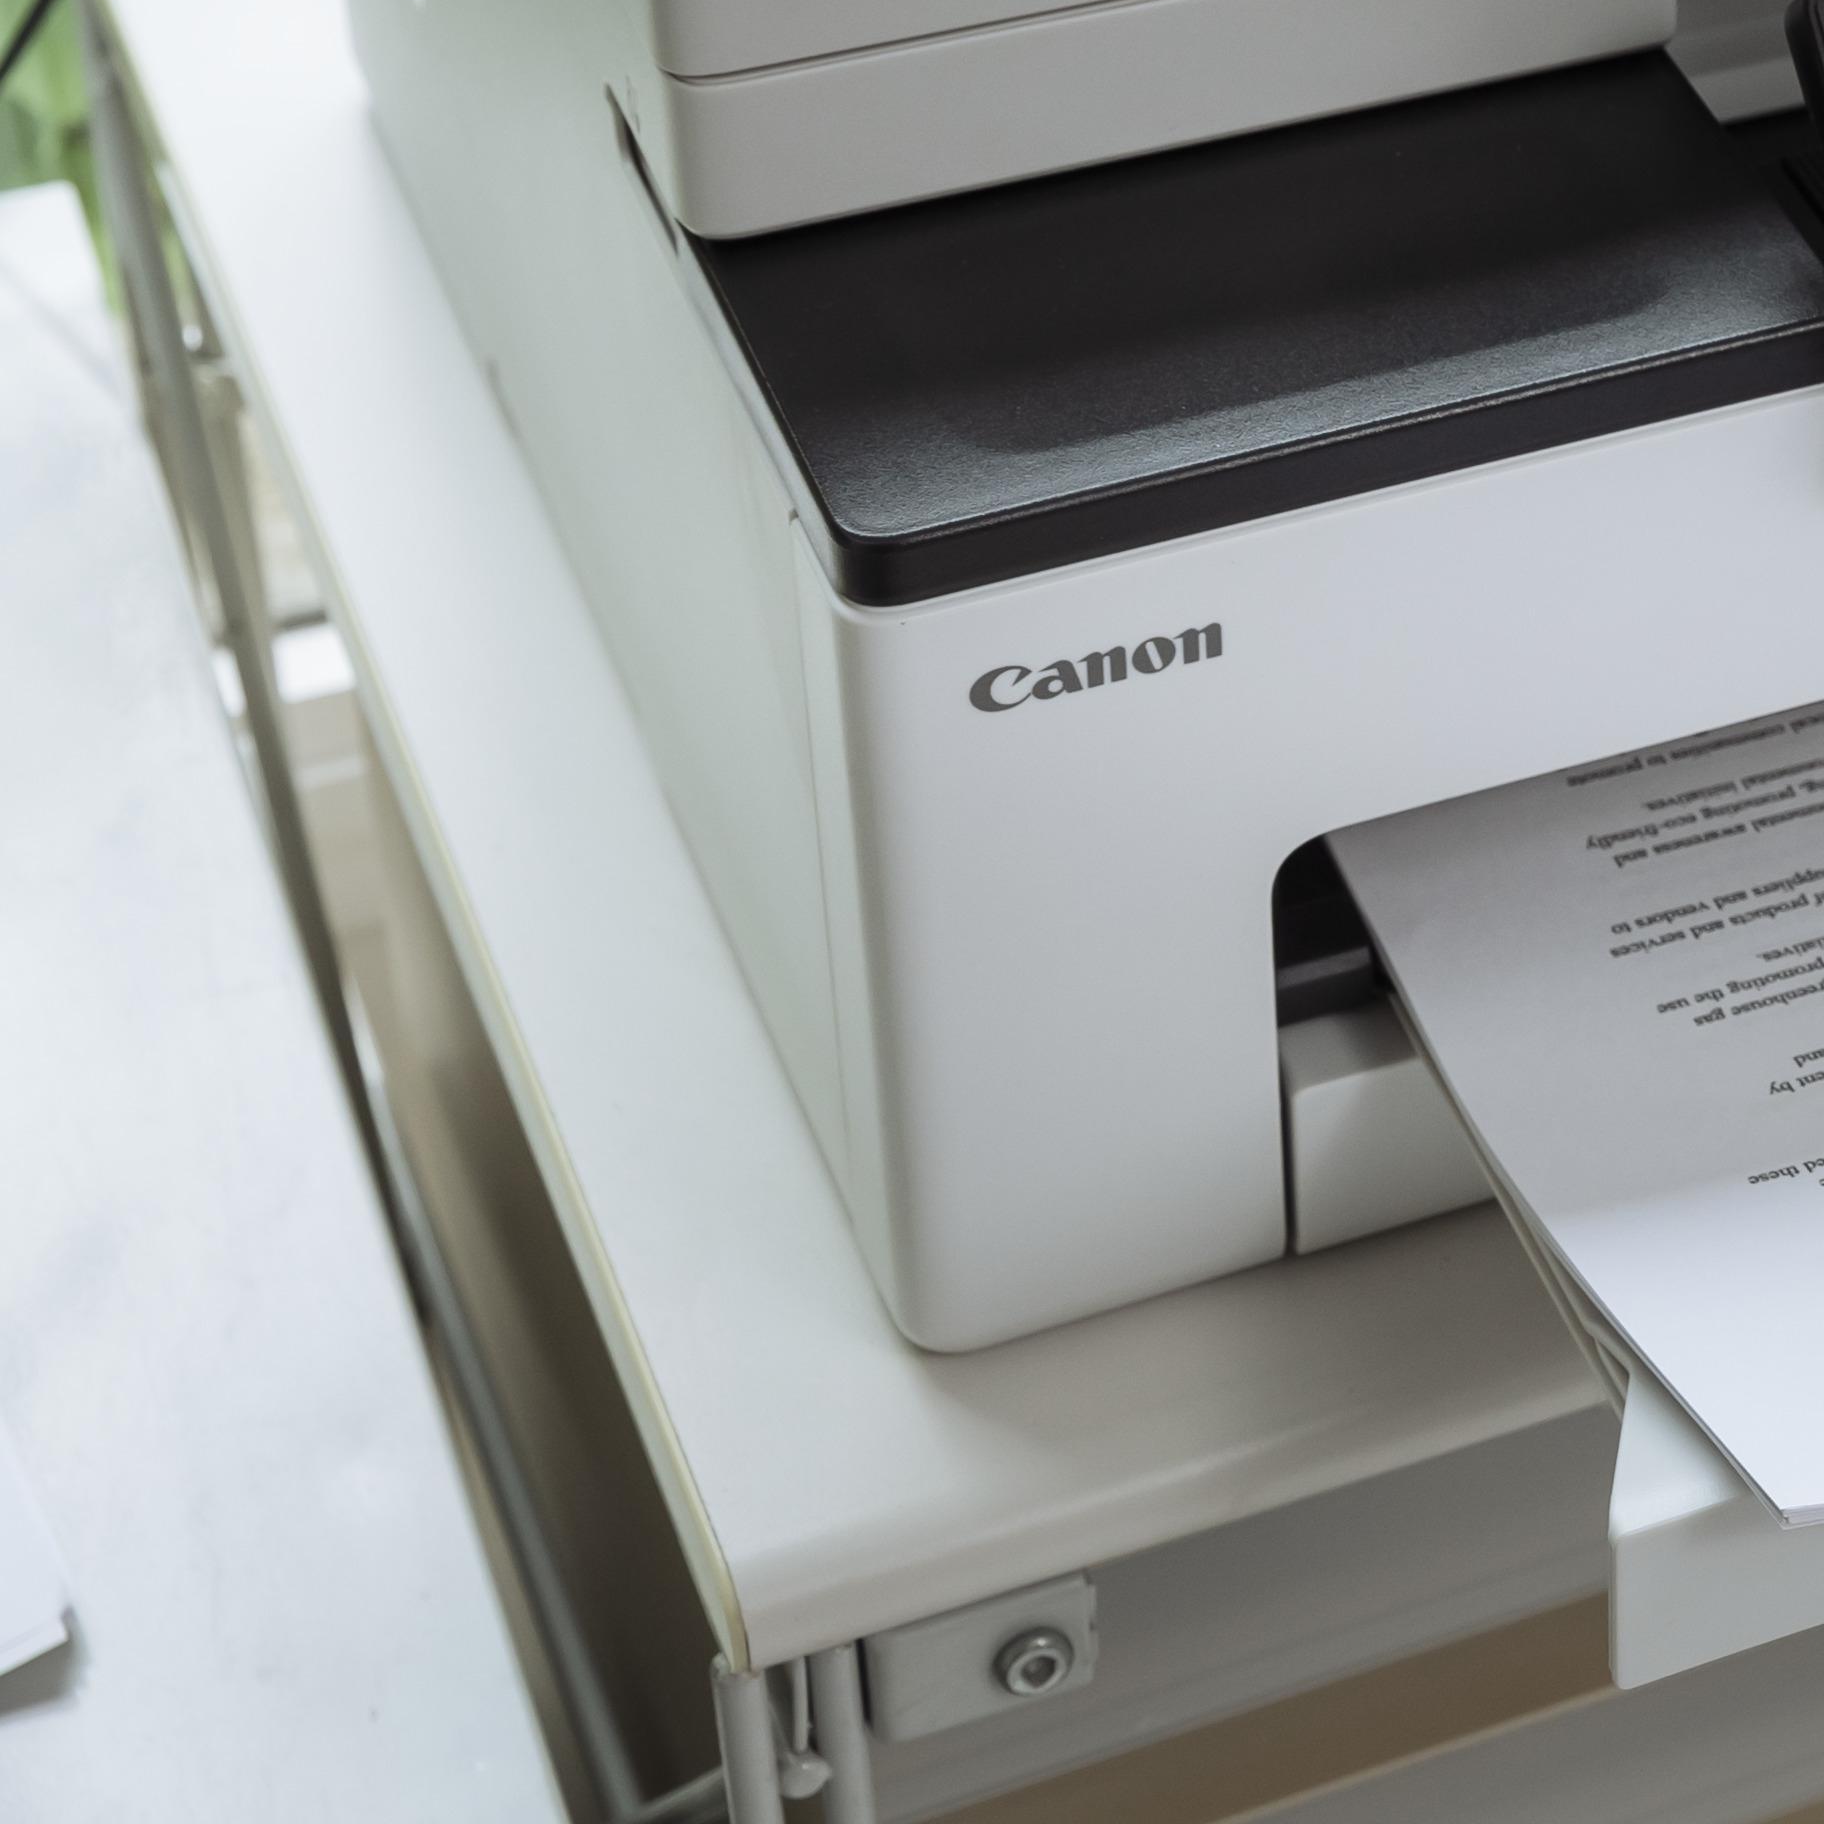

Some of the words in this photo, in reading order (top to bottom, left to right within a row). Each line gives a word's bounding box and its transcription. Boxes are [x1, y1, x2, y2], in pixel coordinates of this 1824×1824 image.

[968, 622, 1223, 713] Canon
[1655, 996, 1691, 1015] use
[1693, 987, 1726, 1004] the
[1692, 1006, 1727, 1028] gas
[1769, 1080, 1796, 1096] by
[1747, 1164, 1801, 1186] these
